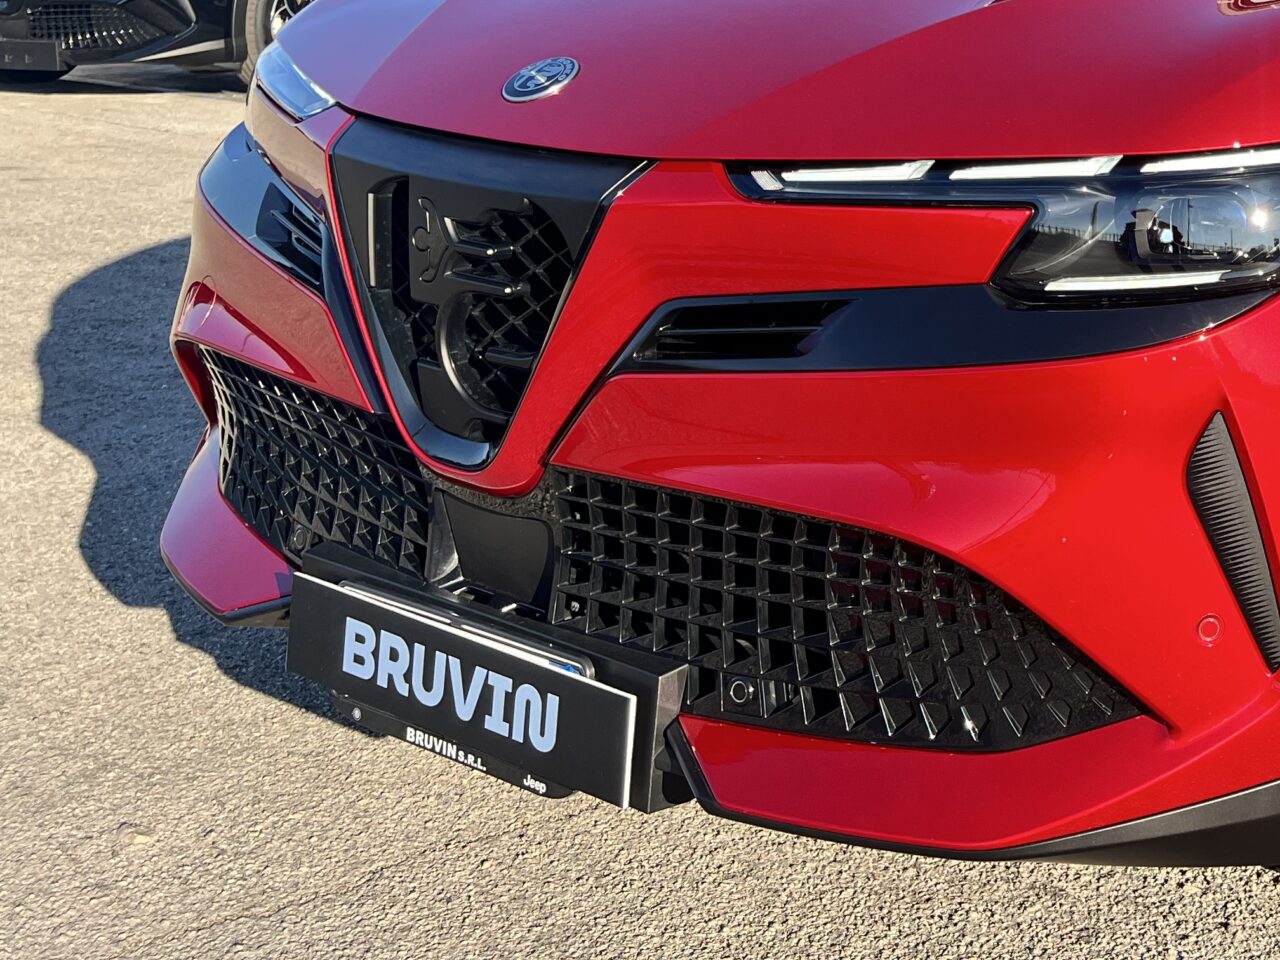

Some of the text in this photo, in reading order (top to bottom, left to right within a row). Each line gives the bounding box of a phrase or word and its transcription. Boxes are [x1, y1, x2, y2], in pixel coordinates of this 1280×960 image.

[342, 616, 560, 754] BRUVIN
[406, 726, 457, 760] BRUVIN
[523, 773, 547, 794] Jeep
